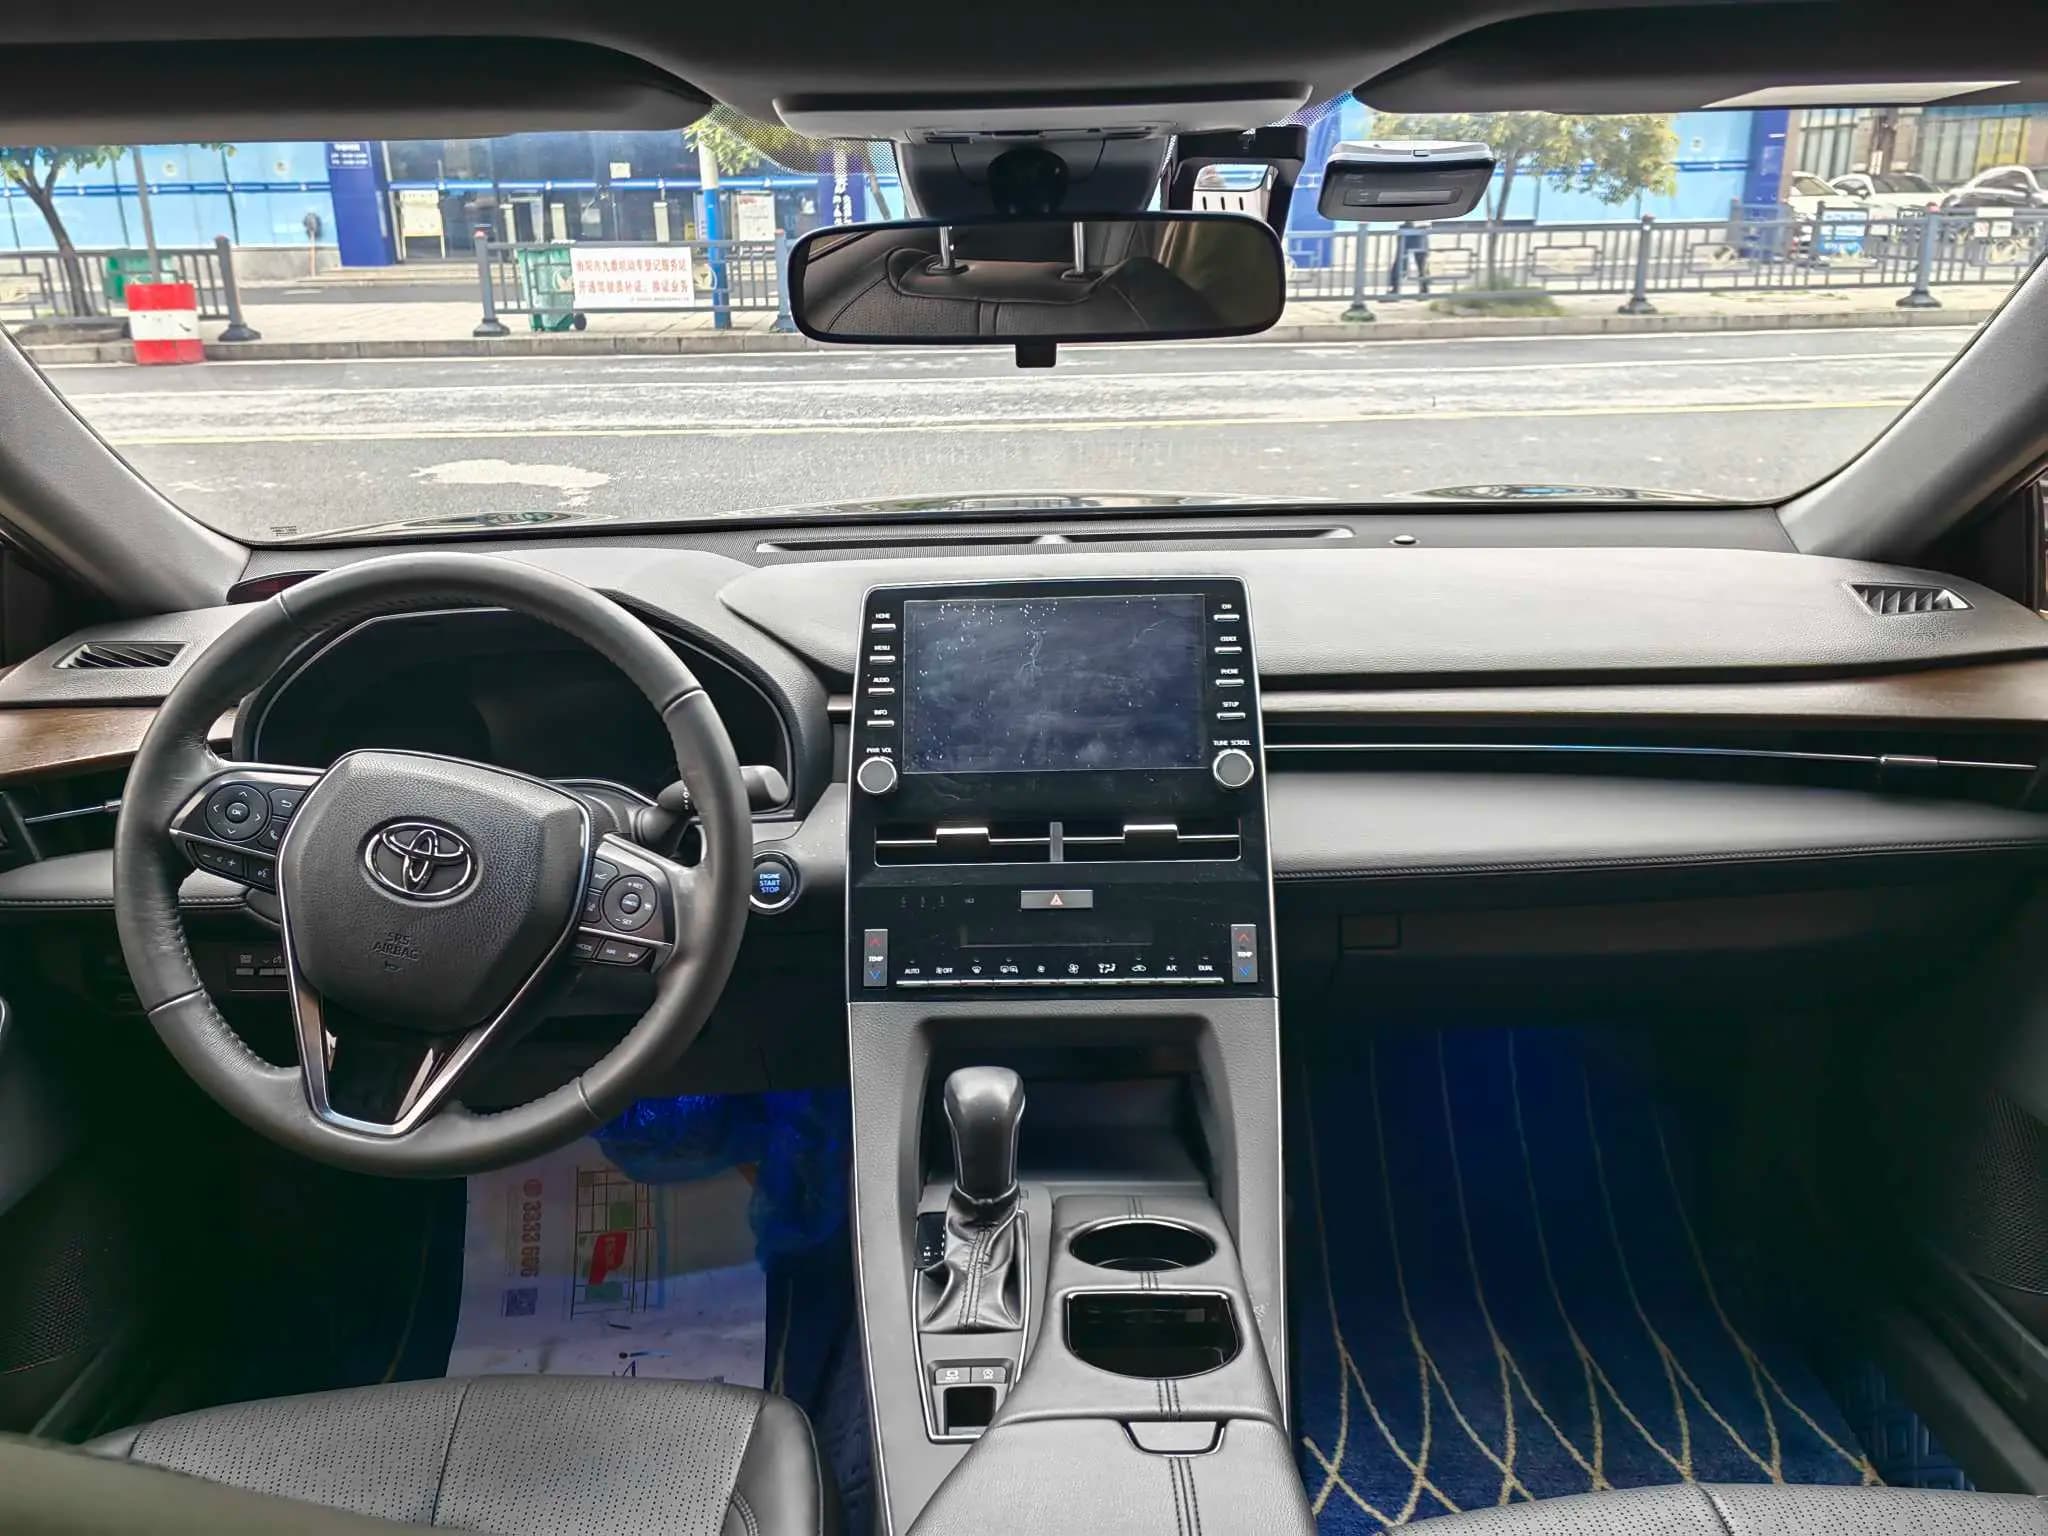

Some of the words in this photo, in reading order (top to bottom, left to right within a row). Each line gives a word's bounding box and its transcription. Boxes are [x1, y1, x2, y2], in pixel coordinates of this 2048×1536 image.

[231, 808, 242, 816] OK
[761, 886, 780, 894] STOP
[386, 931, 410, 946] SRS
[373, 941, 419, 961] AIRBAG
[1166, 964, 1178, 972] A/C
